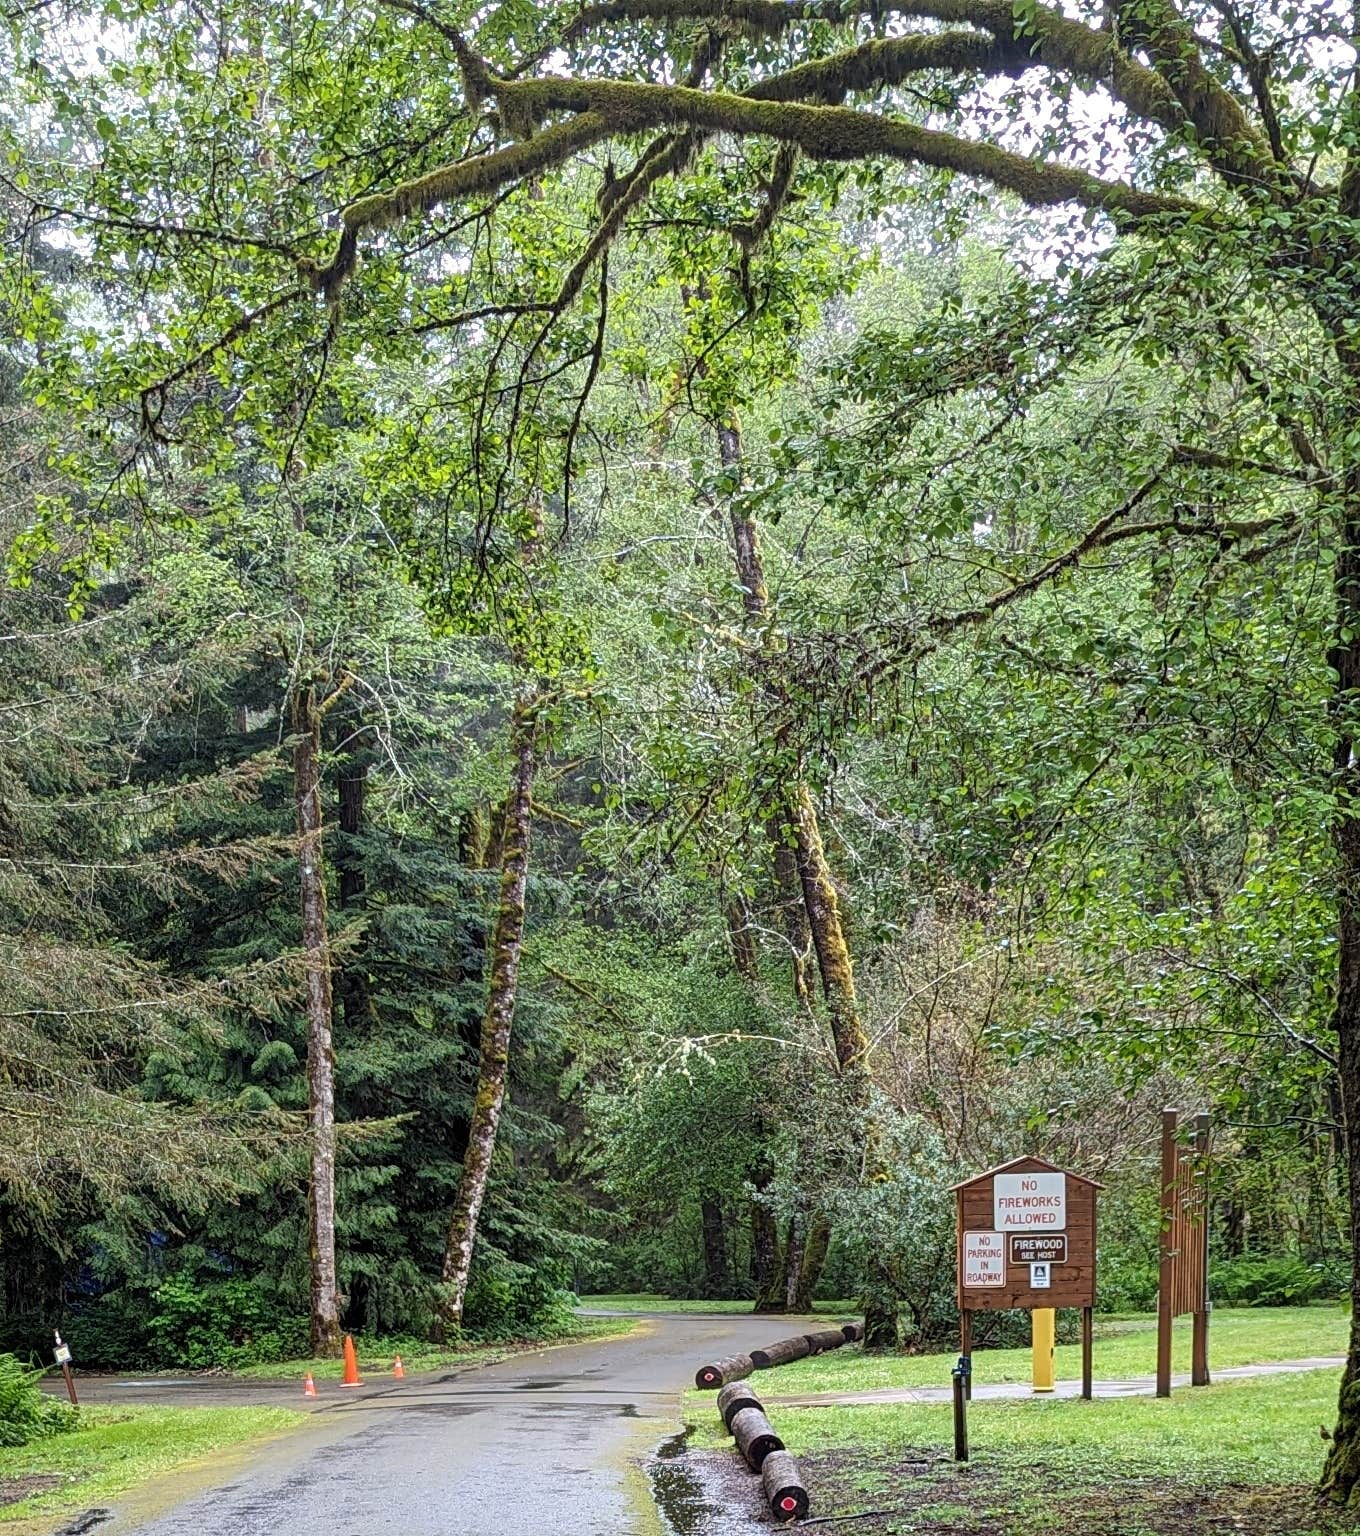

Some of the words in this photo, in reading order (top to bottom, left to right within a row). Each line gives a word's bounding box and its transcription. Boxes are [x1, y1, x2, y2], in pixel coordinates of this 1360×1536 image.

[1021, 1180, 1038, 1191] NO
[998, 1196, 1061, 1208] FIREWORKS
[1004, 1213, 1056, 1224] ALLOWED
[978, 1236, 990, 1246] NO
[1014, 1239, 1063, 1250] FIREWOOD
[967, 1249, 1002, 1259] PARKING
[1037, 1250, 1056, 1260] HOST
[980, 1261, 989, 1270] IN
[967, 1273, 1002, 1283] ROADWAY
